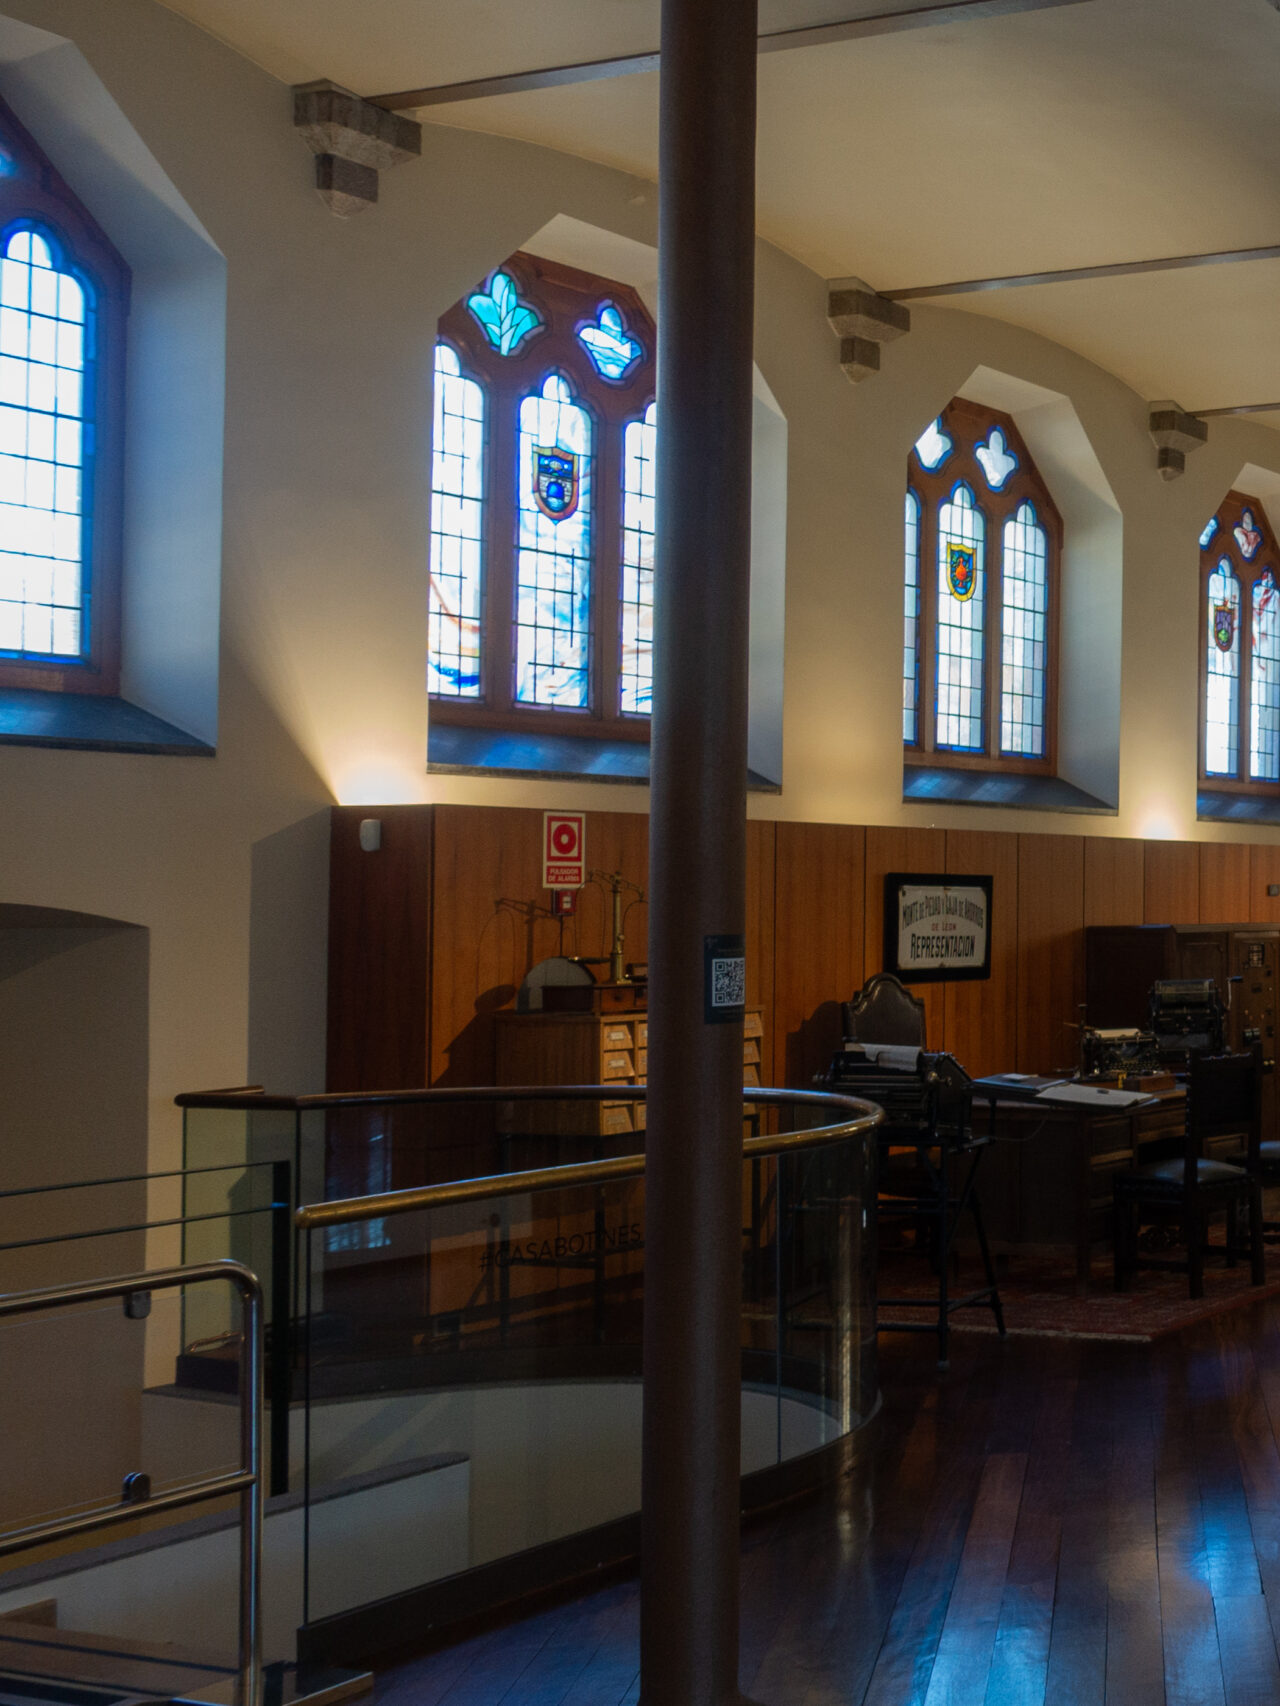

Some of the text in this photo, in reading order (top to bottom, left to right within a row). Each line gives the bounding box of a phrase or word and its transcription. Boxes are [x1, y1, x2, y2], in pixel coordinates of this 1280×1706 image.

[903, 901, 918, 930] MONTE
[945, 894, 958, 915] CAJA
[965, 898, 984, 929] AHORROS
[910, 933, 976, 960] REPRESENTACION
